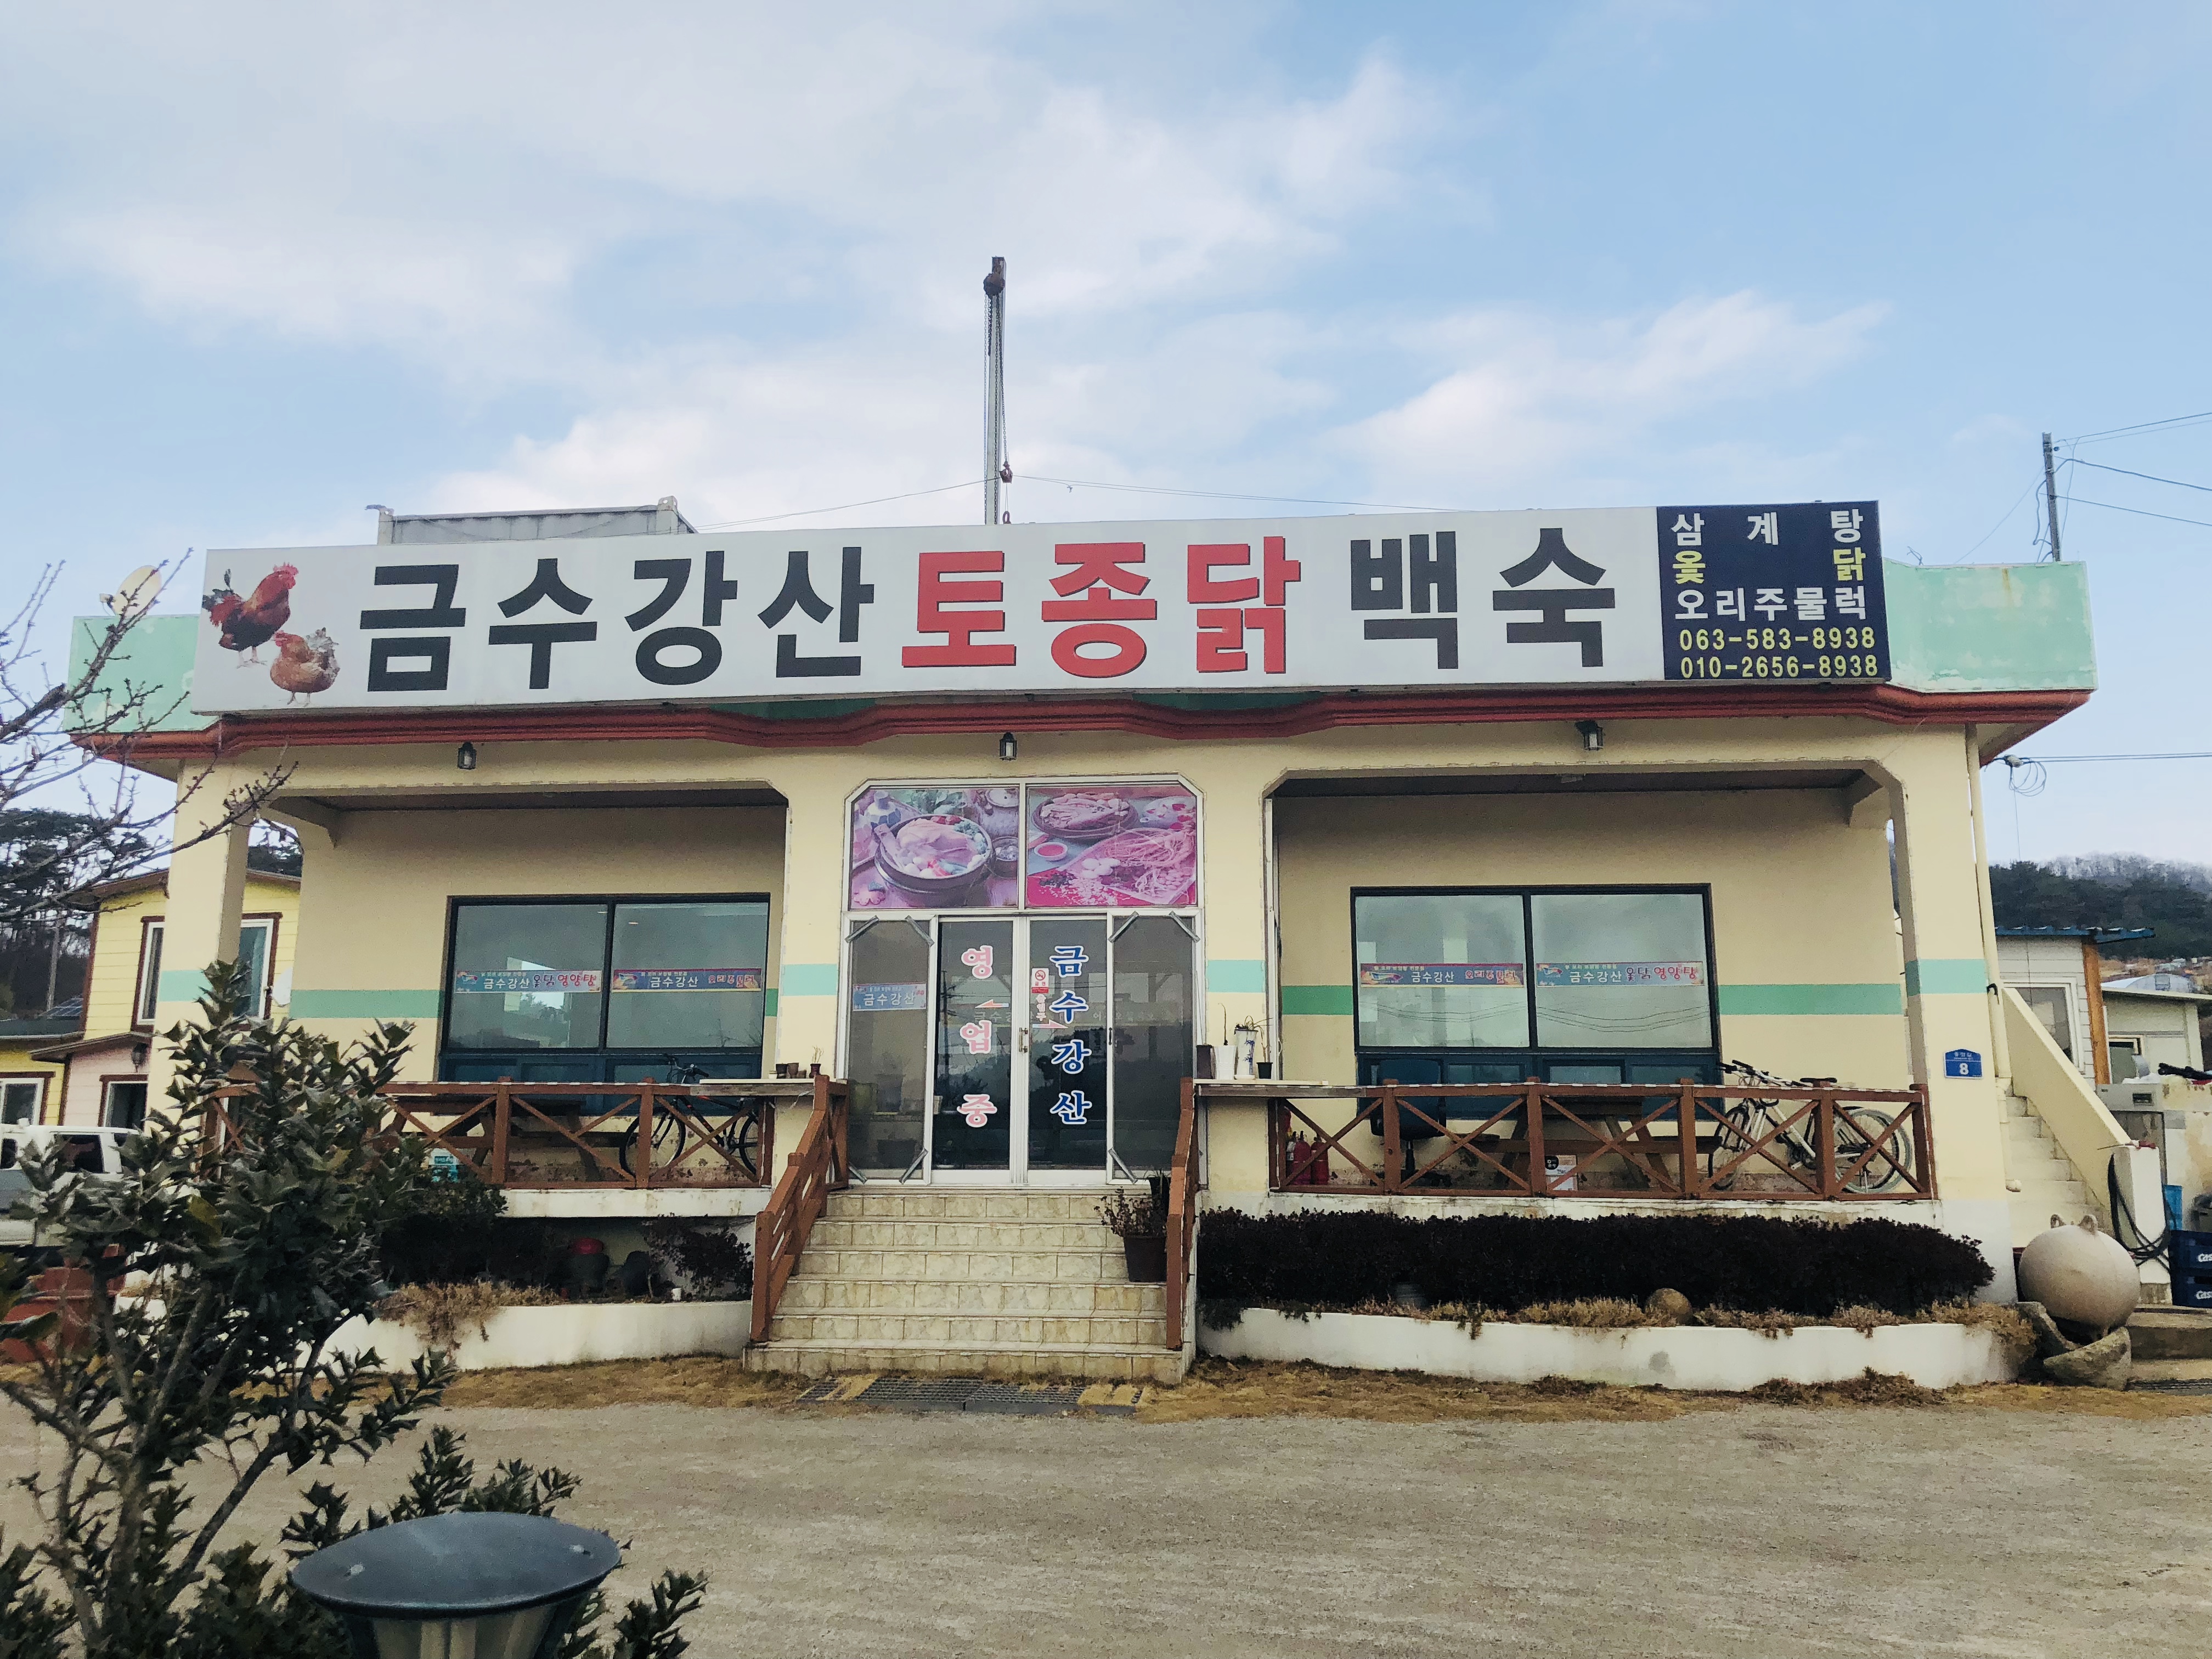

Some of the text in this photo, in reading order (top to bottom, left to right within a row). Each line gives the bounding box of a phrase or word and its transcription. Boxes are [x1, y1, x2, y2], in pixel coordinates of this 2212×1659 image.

[360, 528, 1615, 692] 금수강산 토종닭 백숙
[1675, 585, 1866, 622] 오리주물럭
[1680, 627, 1875, 651] 063-583-8938
[1681, 655, 1877, 678] 010-2656-8938
[483, 978, 530, 989] 금수강산
[650, 977, 698, 988] 금수강산
[1411, 971, 1454, 983] 금수강산
[1570, 971, 1622, 983] 금수강산
[864, 991, 915, 1006] 금수강산
[1049, 945, 1092, 1125] 금수강산
[1959, 1063, 1970, 1075] 8
